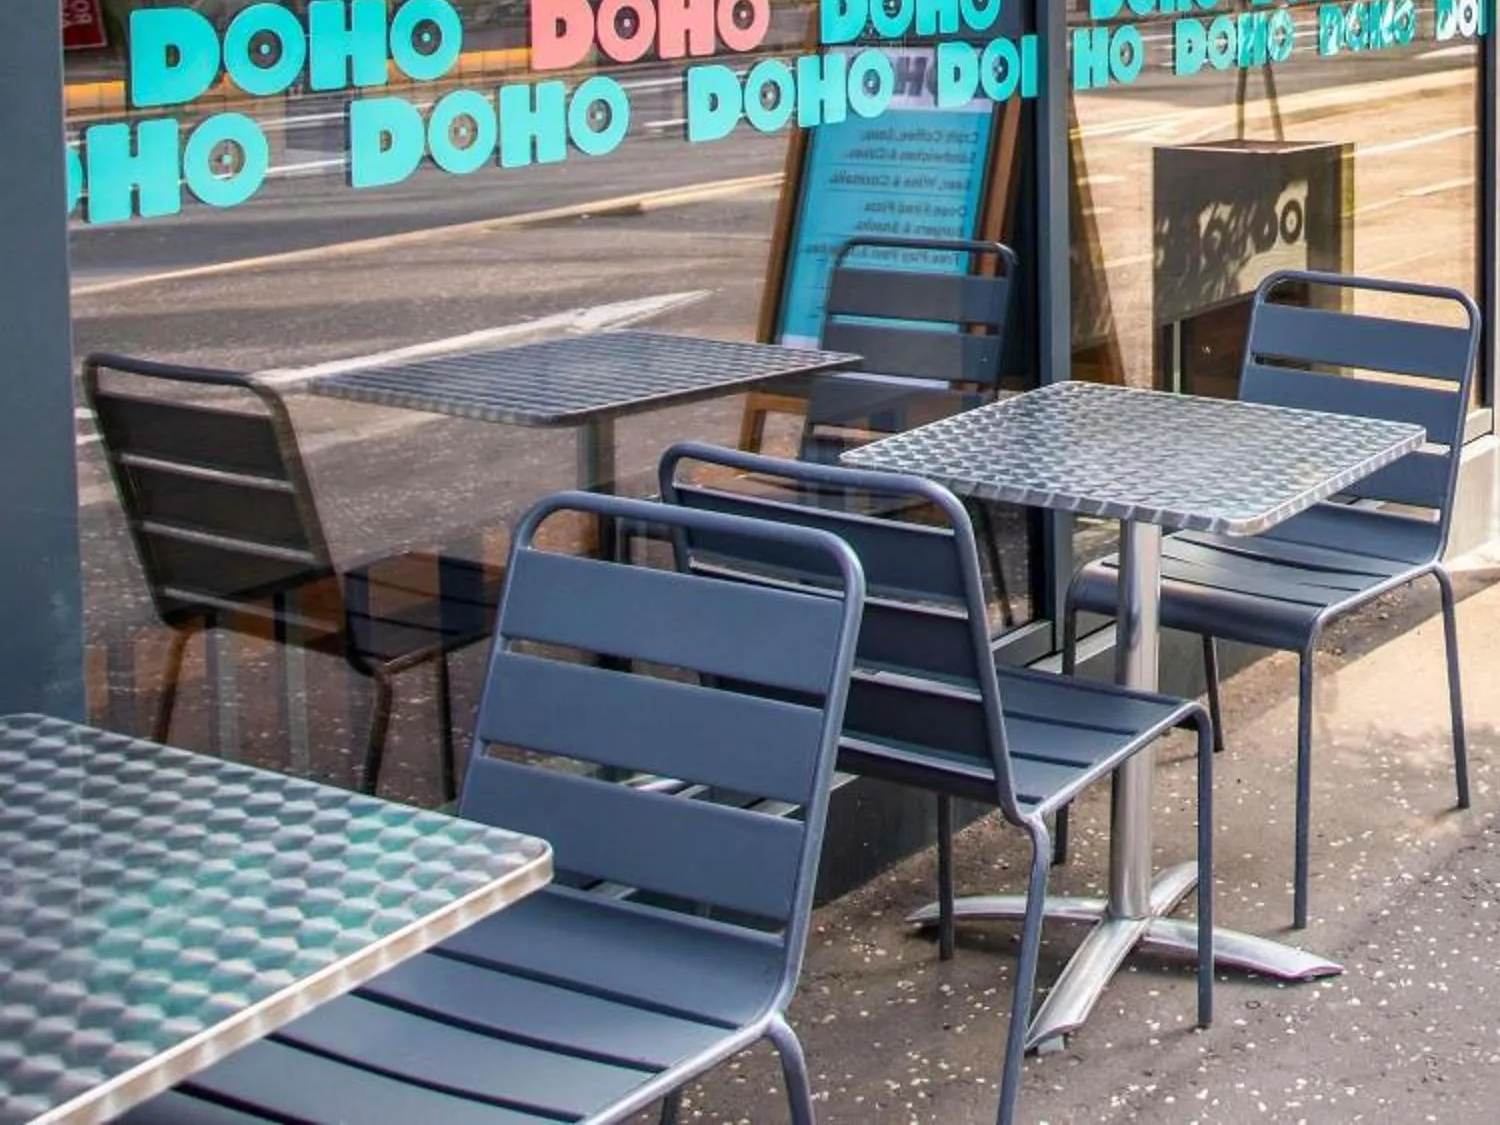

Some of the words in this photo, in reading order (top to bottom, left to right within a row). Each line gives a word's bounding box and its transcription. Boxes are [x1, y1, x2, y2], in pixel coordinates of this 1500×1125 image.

[1175, 8, 1294, 76] DOHO
[350, 77, 630, 188] DOHO
[687, 49, 895, 143] DOHO
